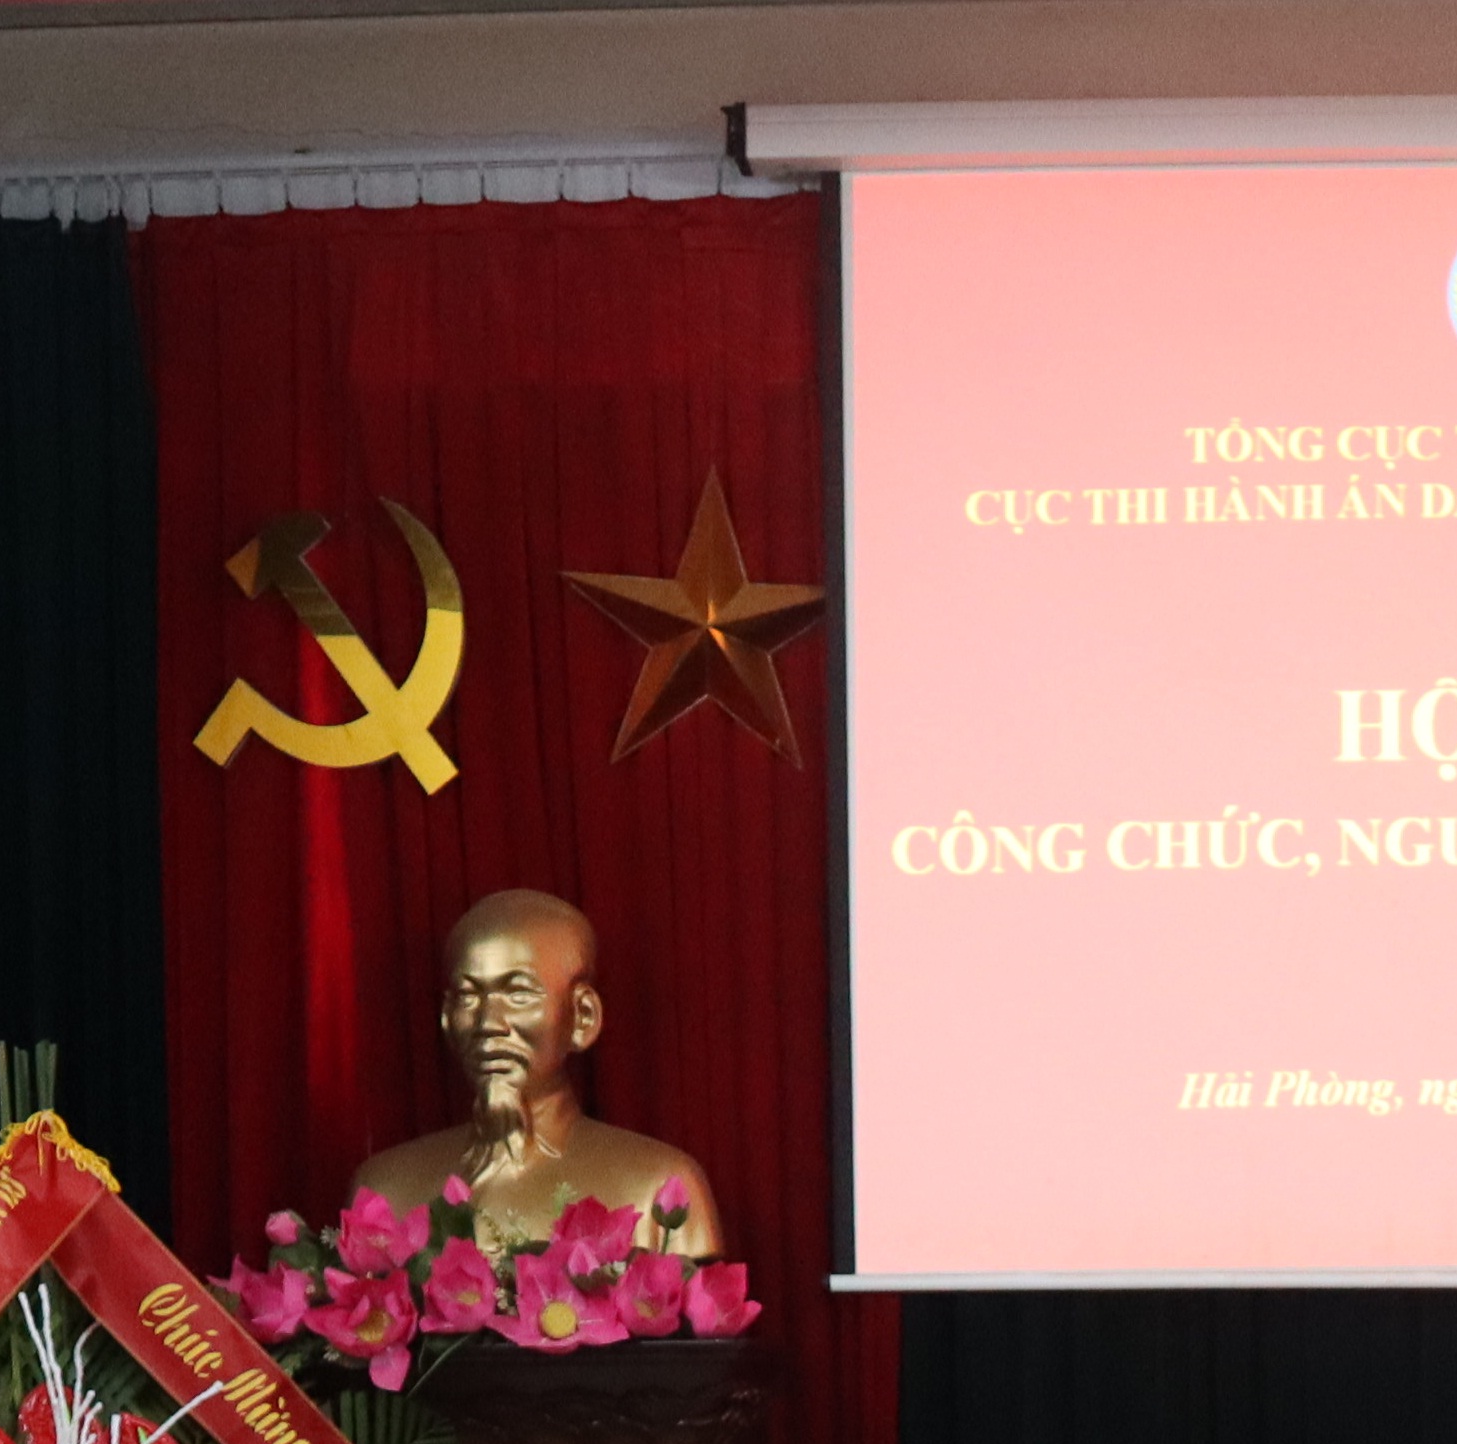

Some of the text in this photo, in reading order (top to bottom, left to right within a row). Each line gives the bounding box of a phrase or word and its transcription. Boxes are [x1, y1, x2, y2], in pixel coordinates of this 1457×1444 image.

[1185, 417, 1325, 463] TỔNG
[1337, 425, 1443, 470] CỤC
[966, 488, 1070, 535] CỤC
[1084, 487, 1169, 524] THI
[1184, 476, 1325, 523] HÀNH
[1337, 474, 1407, 519] ÁN
[890, 809, 1087, 877] CÔNG
[1106, 806, 1322, 878] CHỨC,
[1177, 1071, 1254, 1111] Hải
[1263, 1069, 1405, 1117] Phòng,
[138, 1283, 224, 1379] Chúc
